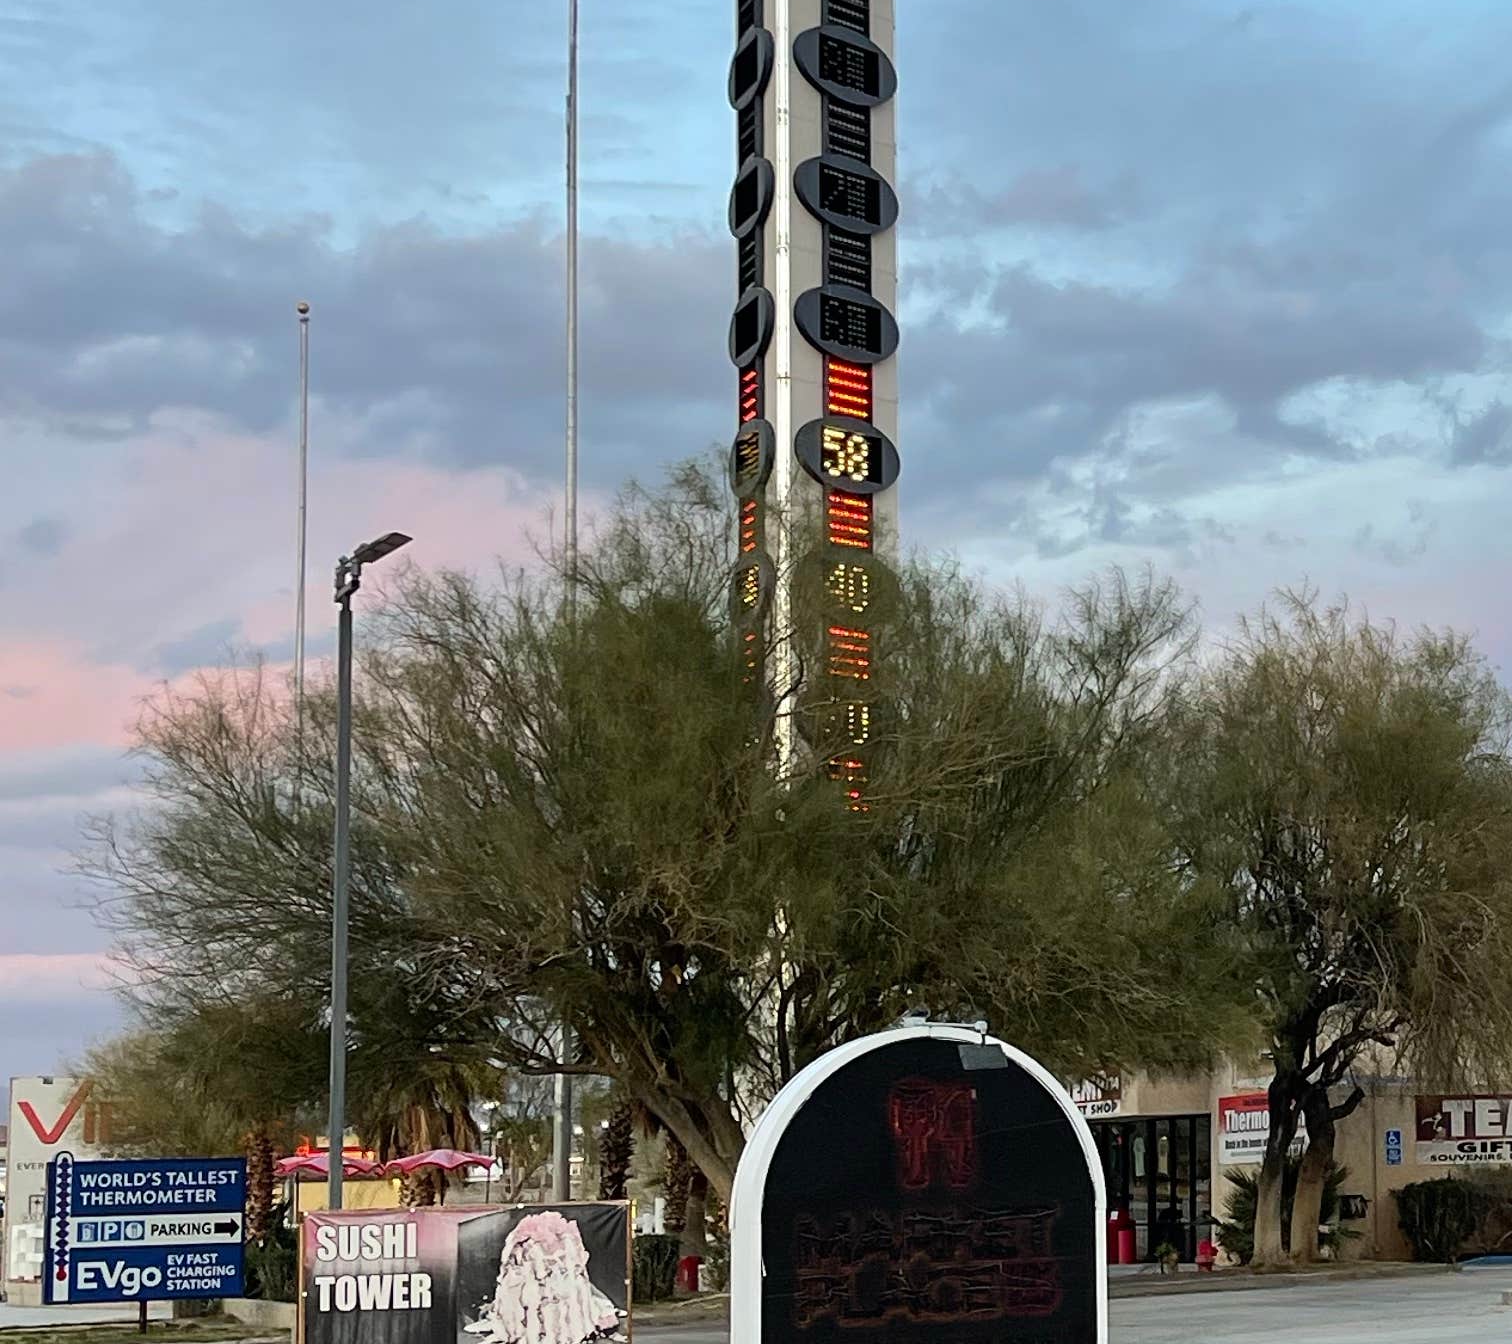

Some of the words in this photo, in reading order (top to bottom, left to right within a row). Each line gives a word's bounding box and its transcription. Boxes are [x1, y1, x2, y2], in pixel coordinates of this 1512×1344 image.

[823, 428, 869, 482] 58
[1091, 1101, 1118, 1114] SHOP
[80, 1172, 162, 1188] WORLD'S
[166, 1170, 239, 1186] TALLEST
[80, 1189, 217, 1206] THERMOMETER
[151, 1222, 213, 1237] PARKING
[316, 1222, 418, 1261] SUSHI
[167, 1254, 185, 1266] EV
[187, 1253, 219, 1265] FAST
[77, 1260, 162, 1296] EVgo
[167, 1265, 236, 1279] CHARGING
[167, 1278, 221, 1291] STATION
[315, 1272, 432, 1312] TOWER
